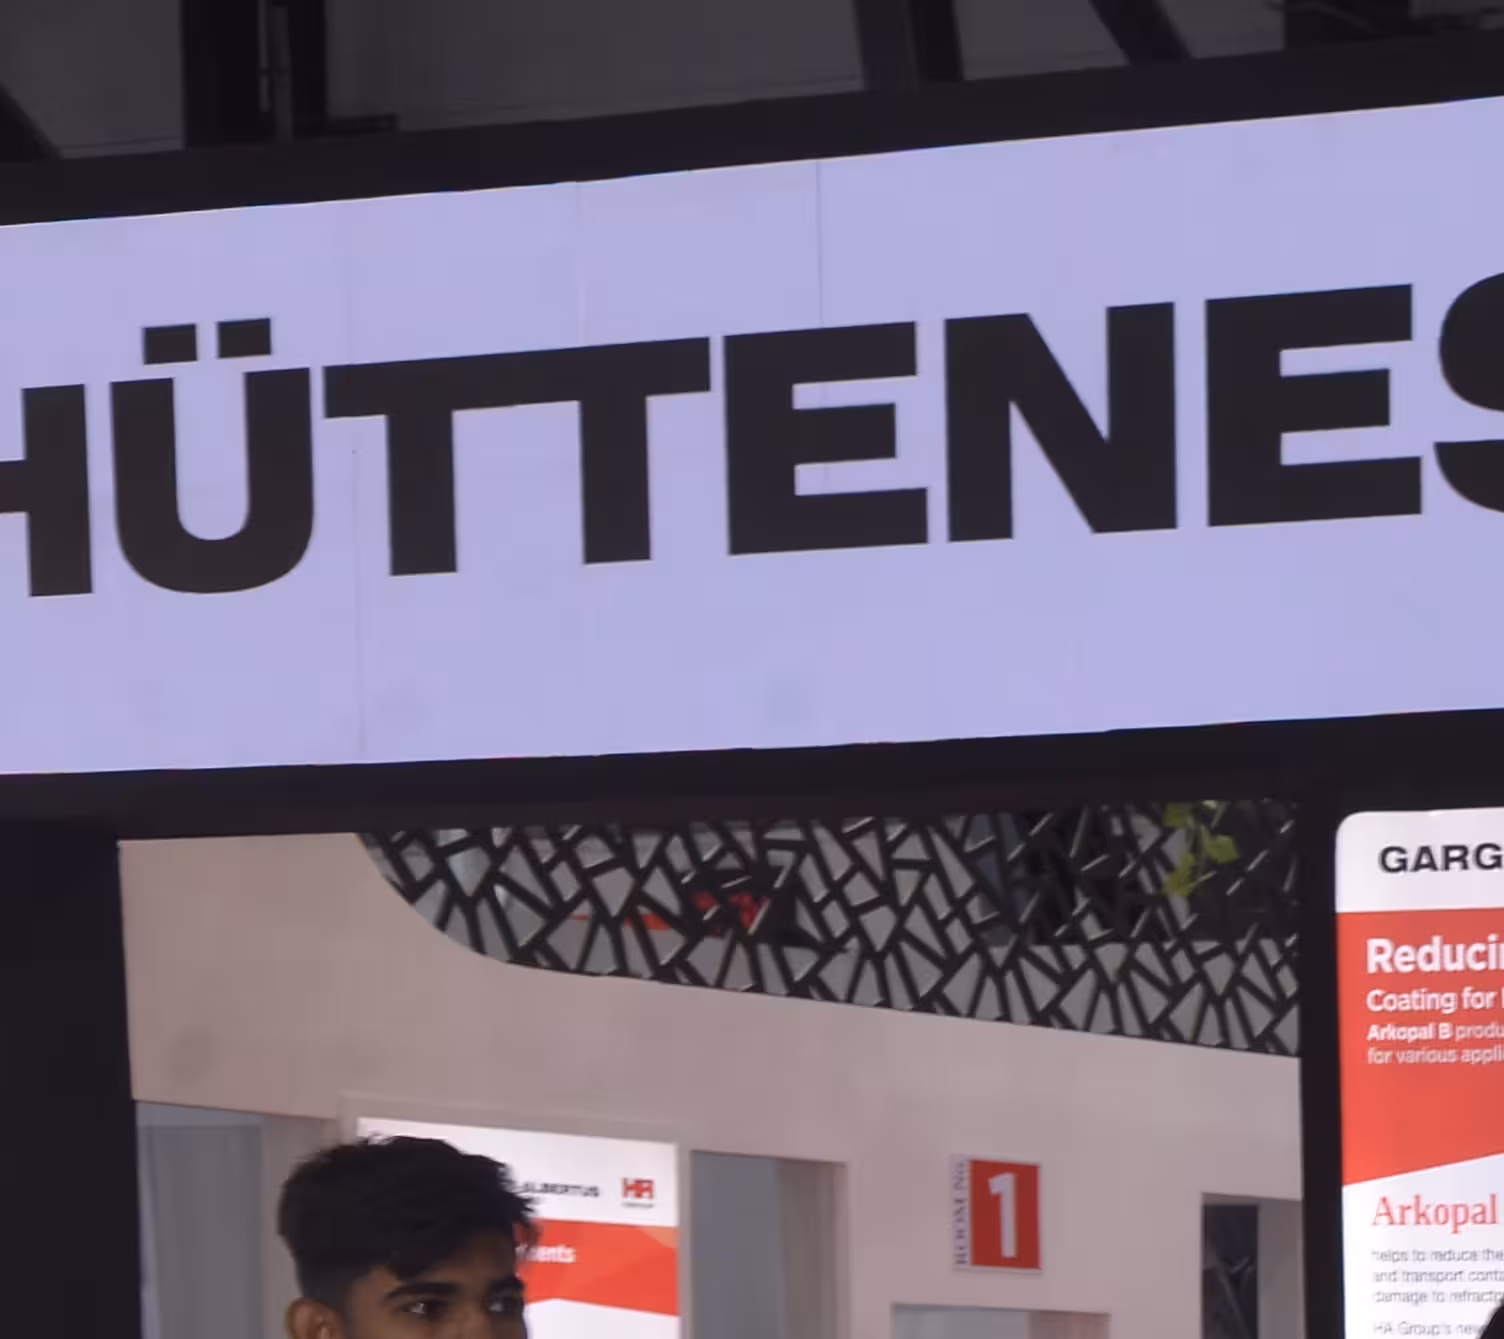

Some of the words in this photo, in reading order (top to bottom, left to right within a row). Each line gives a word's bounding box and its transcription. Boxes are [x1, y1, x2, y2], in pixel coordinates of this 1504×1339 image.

[1366, 988, 1458, 1014] Coating
[1462, 986, 1498, 1010] for
[1367, 1021, 1434, 1043] Arkopal
[1437, 1021, 1452, 1040] B
[1367, 1046, 1392, 1063] for
[1396, 1046, 1456, 1062] various
[988, 1172, 1018, 1259] 1
[1372, 1193, 1498, 1235] Arkopal
